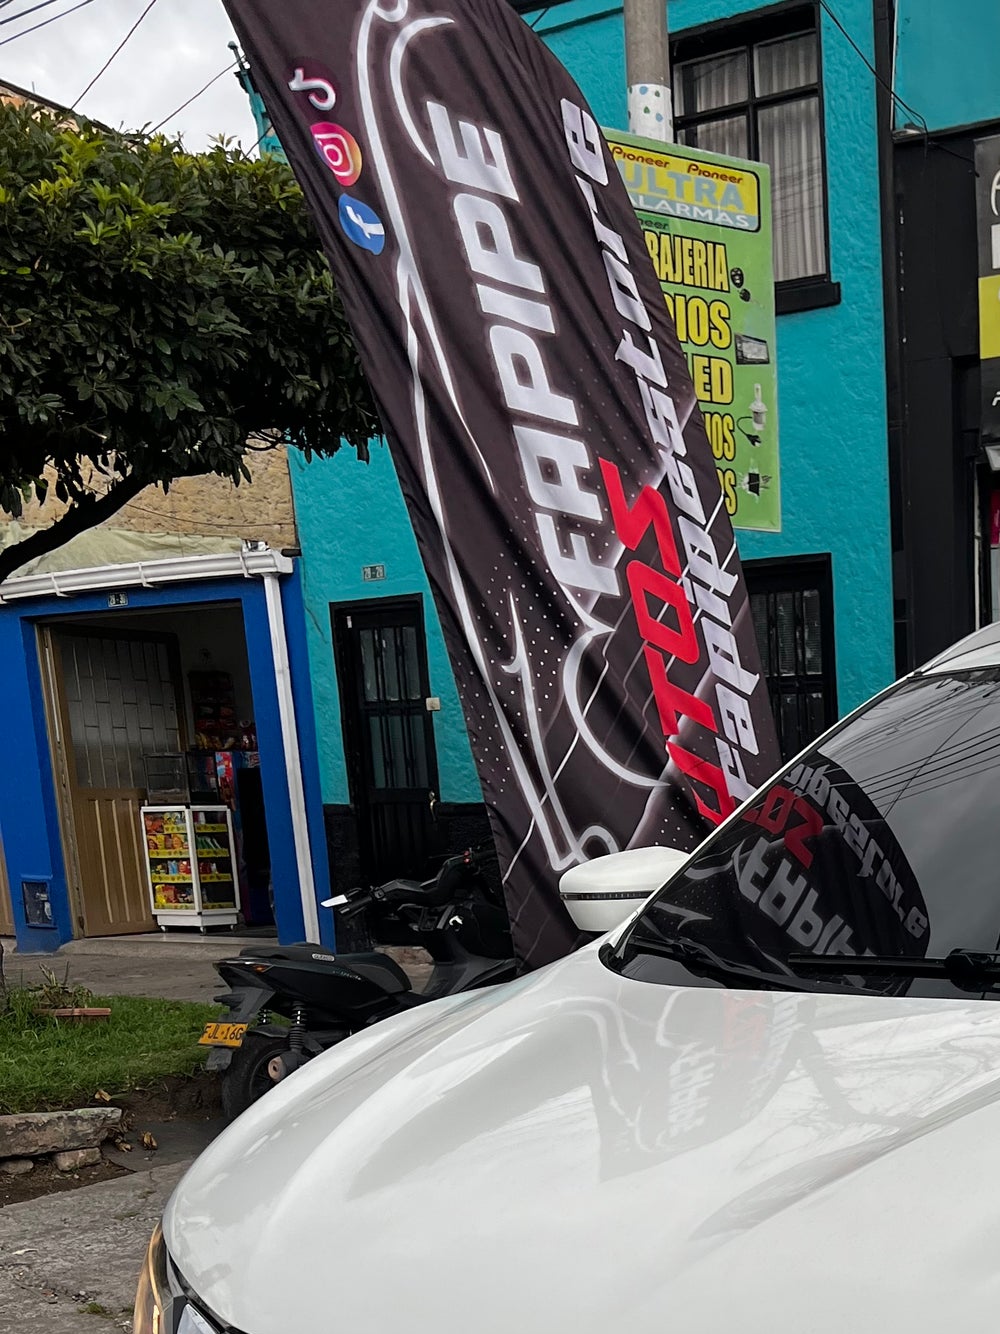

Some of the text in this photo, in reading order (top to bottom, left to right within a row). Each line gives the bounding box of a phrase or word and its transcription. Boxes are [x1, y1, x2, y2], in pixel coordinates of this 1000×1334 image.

[612, 146, 670, 168] Pioneer
[687, 163, 743, 184] Pioneer
[616, 160, 745, 211] ULTRA
[645, 229, 730, 293] RAJERIA
[426, 100, 621, 597] FAPIPE
[690, 353, 734, 405] ED
[599, 457, 736, 827] UTOS
